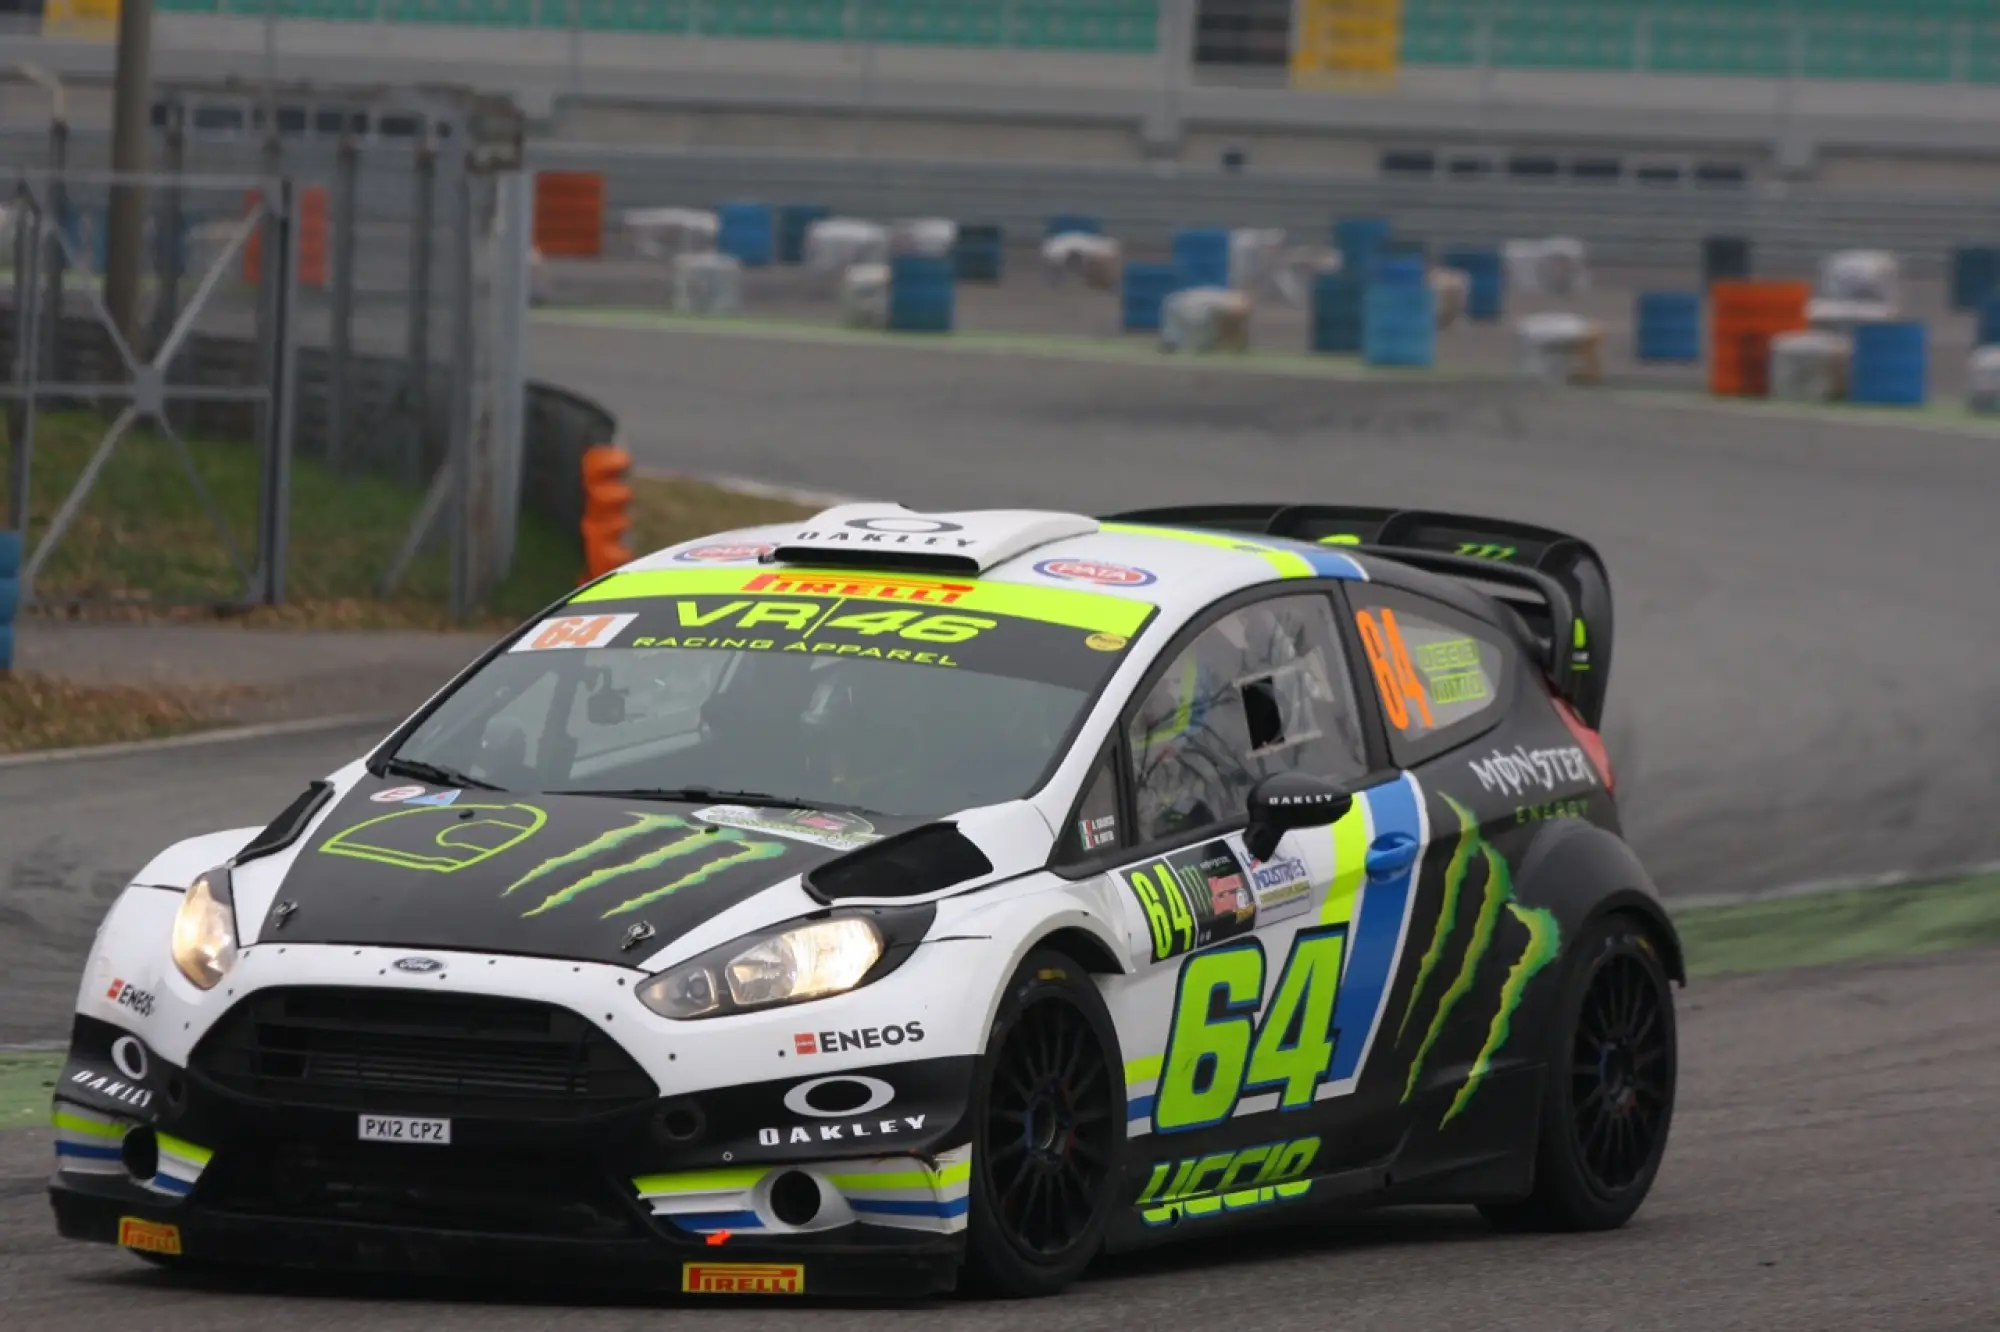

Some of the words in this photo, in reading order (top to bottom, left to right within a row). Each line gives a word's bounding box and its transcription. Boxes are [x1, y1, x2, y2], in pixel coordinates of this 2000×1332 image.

[797, 531, 978, 547] OAKLEY
[740, 573, 975, 604] PIRELLI
[531, 615, 616, 648] 64
[632, 637, 774, 649] RACING
[784, 641, 958, 666] APPAREL
[1355, 608, 1432, 729] 64
[1468, 745, 1596, 797] MONSTER
[1269, 792, 1333, 805] OAKLEY
[1516, 800, 1588, 823] ENERGY
[1130, 864, 1194, 960] 64
[118, 984, 156, 1017] ENEOS
[819, 1020, 925, 1053] ENEOS
[1152, 922, 1350, 1134] 64
[71, 1070, 153, 1108] OAKLEY
[365, 1119, 403, 1138] PX12
[410, 1122, 444, 1140] CPZ
[758, 1114, 926, 1146] OAKLEY
[1133, 1136, 1322, 1226] UCCIO
[122, 1220, 178, 1253] PIRELLI
[688, 1267, 798, 1293] PIRELLI
